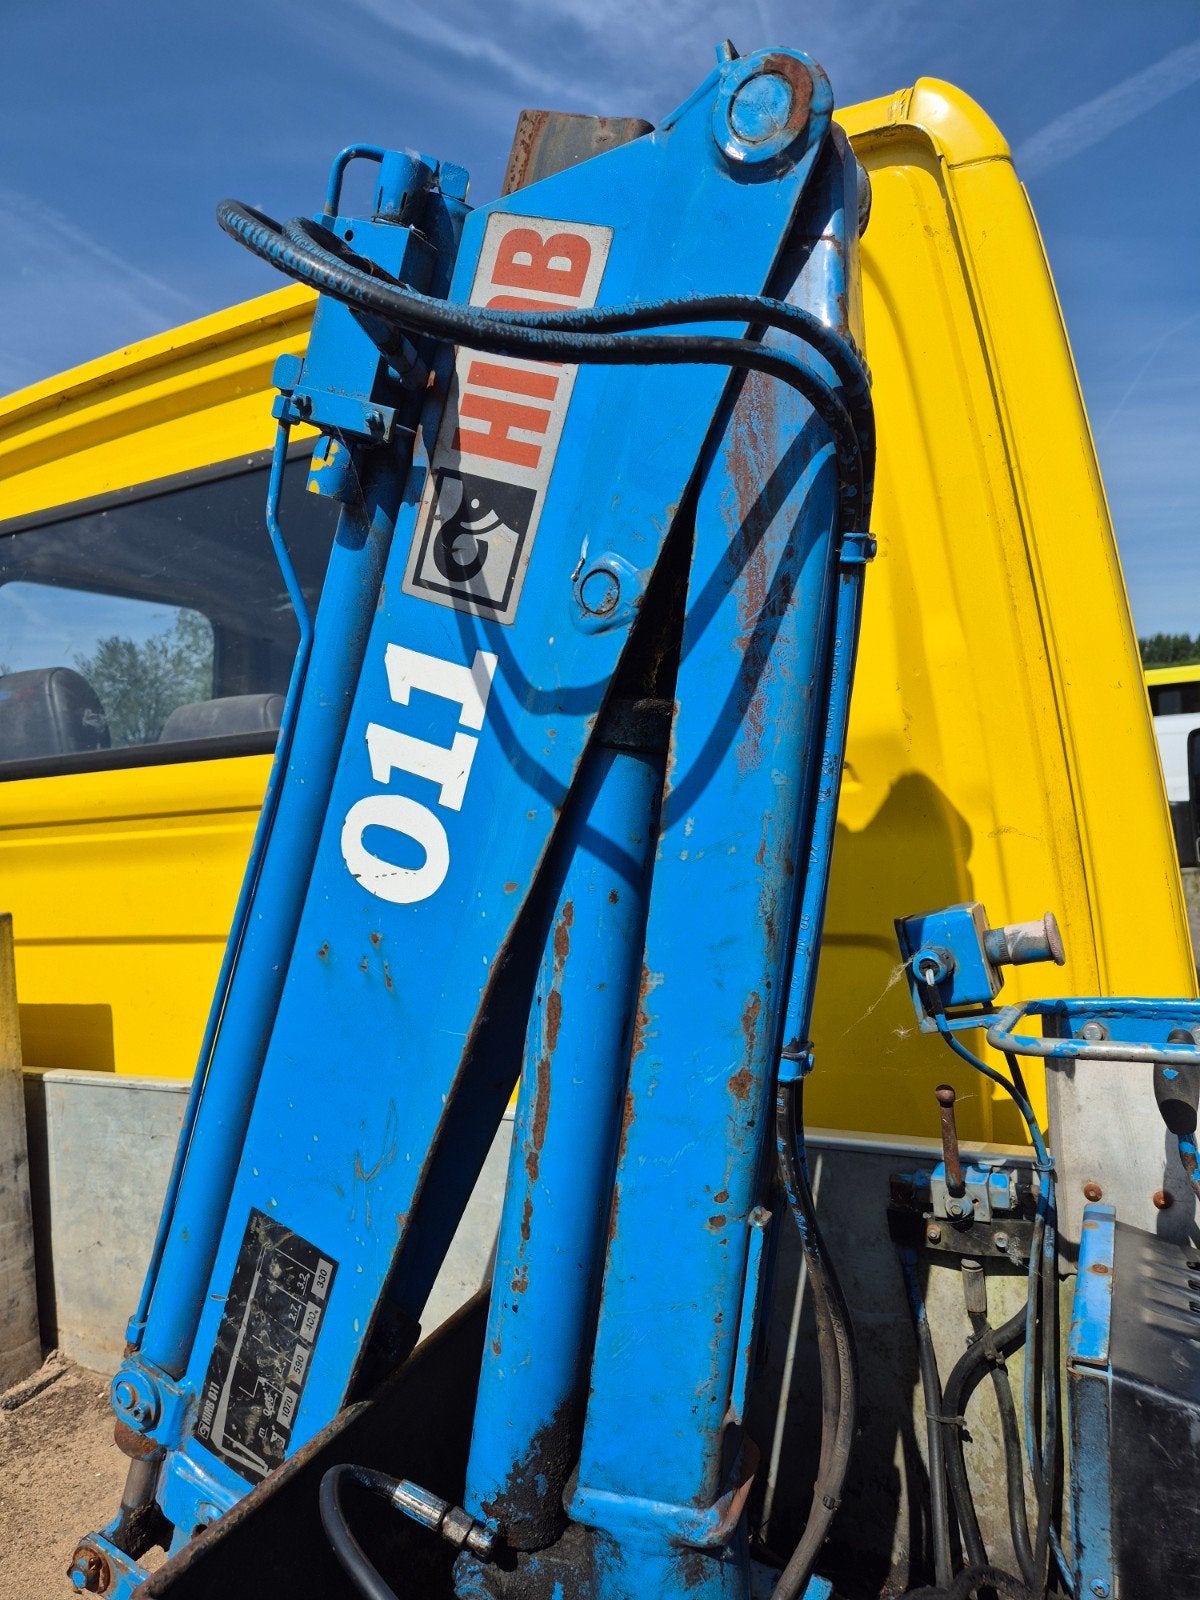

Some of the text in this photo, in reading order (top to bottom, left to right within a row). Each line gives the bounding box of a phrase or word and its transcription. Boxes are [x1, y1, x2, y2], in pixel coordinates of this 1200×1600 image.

[341, 642, 498, 904] 011
[316, 1269, 328, 1288] 330
[294, 1355, 304, 1374] 590
[202, 1381, 220, 1425] HIAB 011
[282, 1396, 293, 1418] 1070
